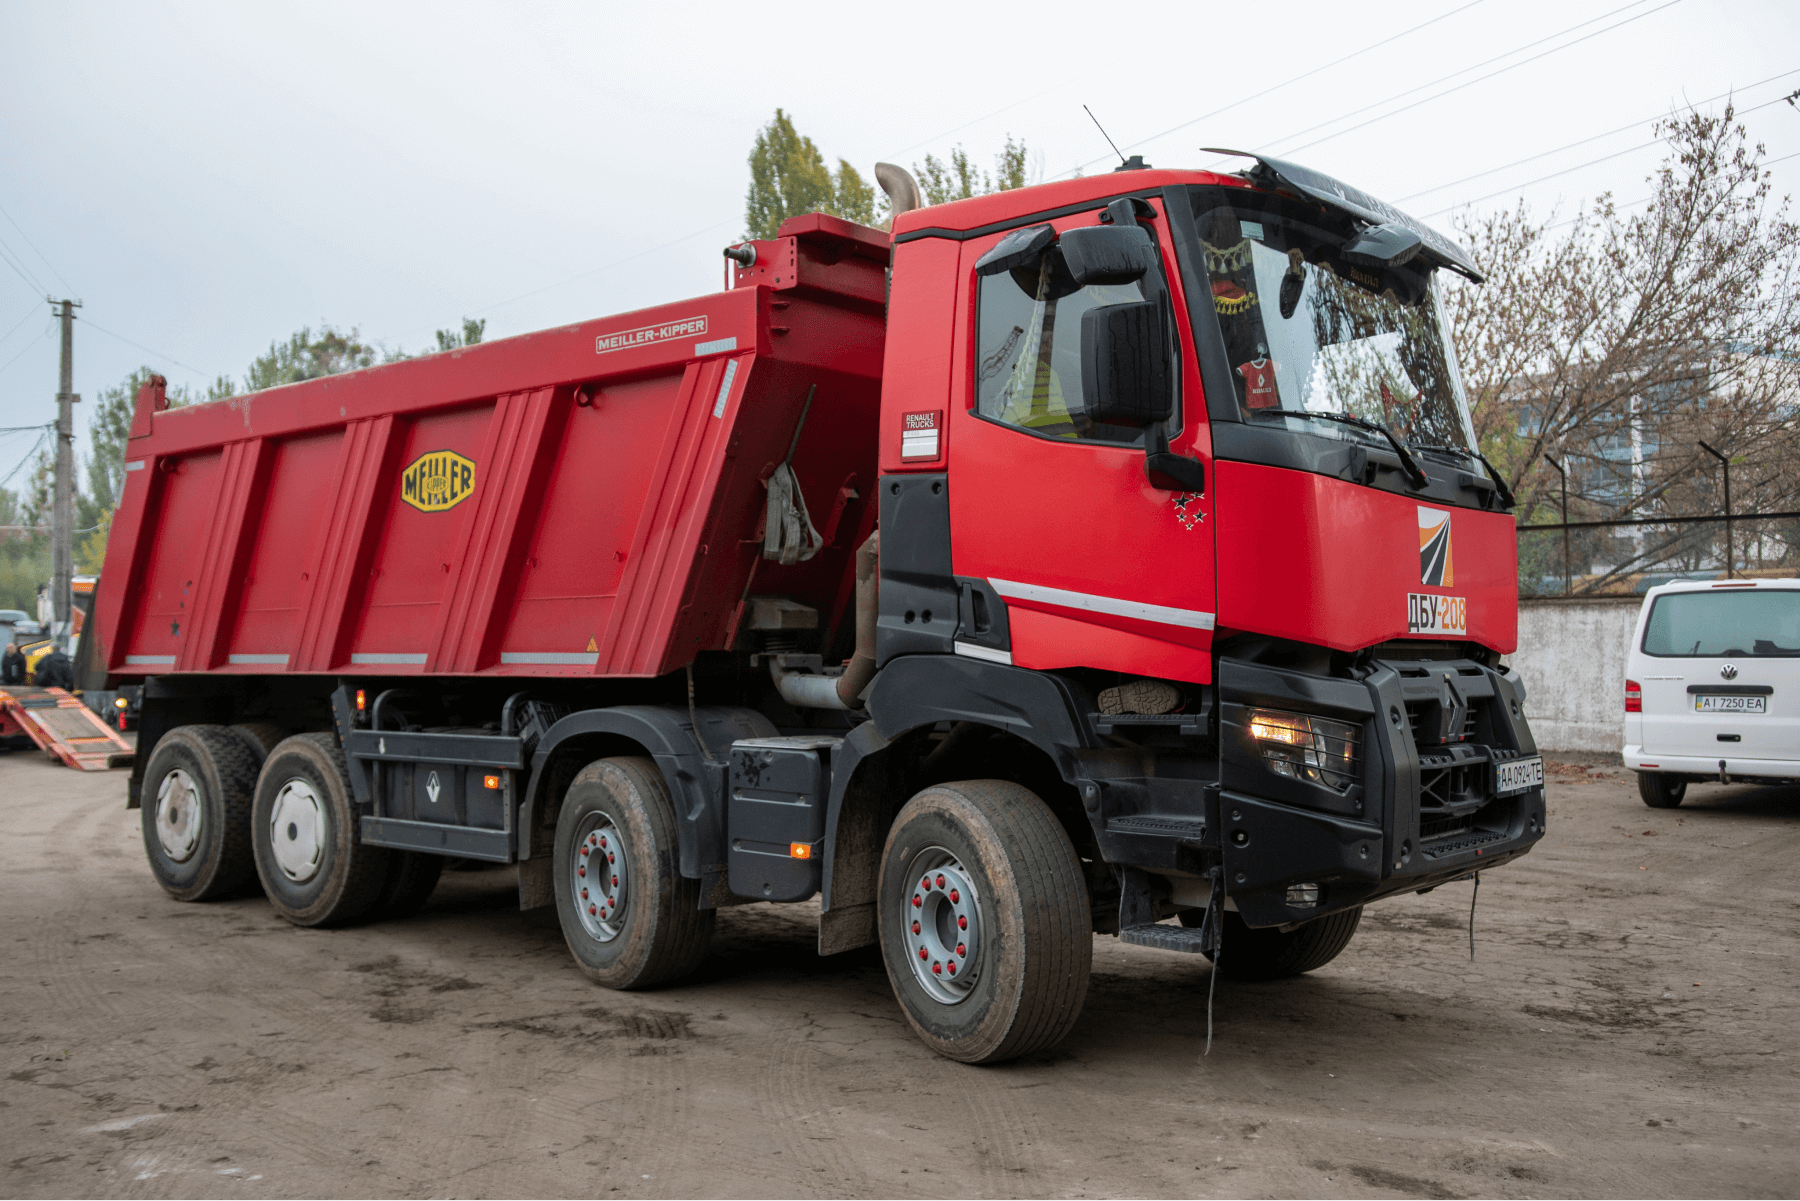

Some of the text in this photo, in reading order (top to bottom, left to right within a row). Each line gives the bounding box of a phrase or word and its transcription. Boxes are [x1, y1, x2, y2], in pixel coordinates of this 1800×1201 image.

[599, 320, 705, 350] MEILLER-KIPPER
[906, 413, 934, 422] RENAULT
[906, 420, 934, 429] TRUCKS
[404, 456, 472, 506] MEILLER
[1408, 594, 1466, 632] ДБУ-208
[1720, 698, 1744, 708] 7250
[1747, 698, 1763, 709] EA
